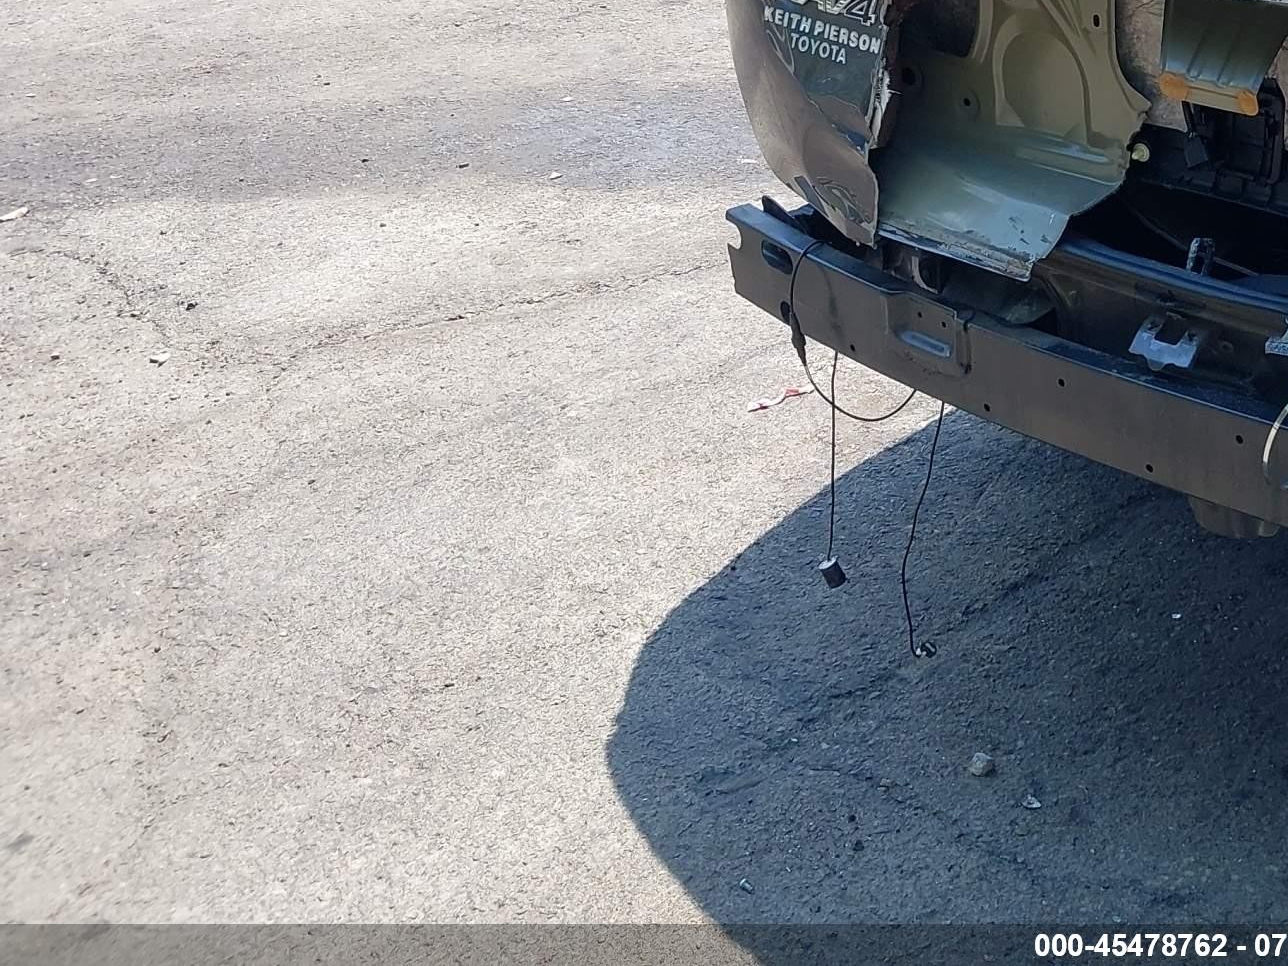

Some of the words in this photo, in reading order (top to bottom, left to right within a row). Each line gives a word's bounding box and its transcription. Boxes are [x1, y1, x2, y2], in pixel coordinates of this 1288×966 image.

[764, 5, 812, 33] KEITH
[814, 20, 881, 54] PIERSON
[790, 32, 846, 64] TOYOTA
